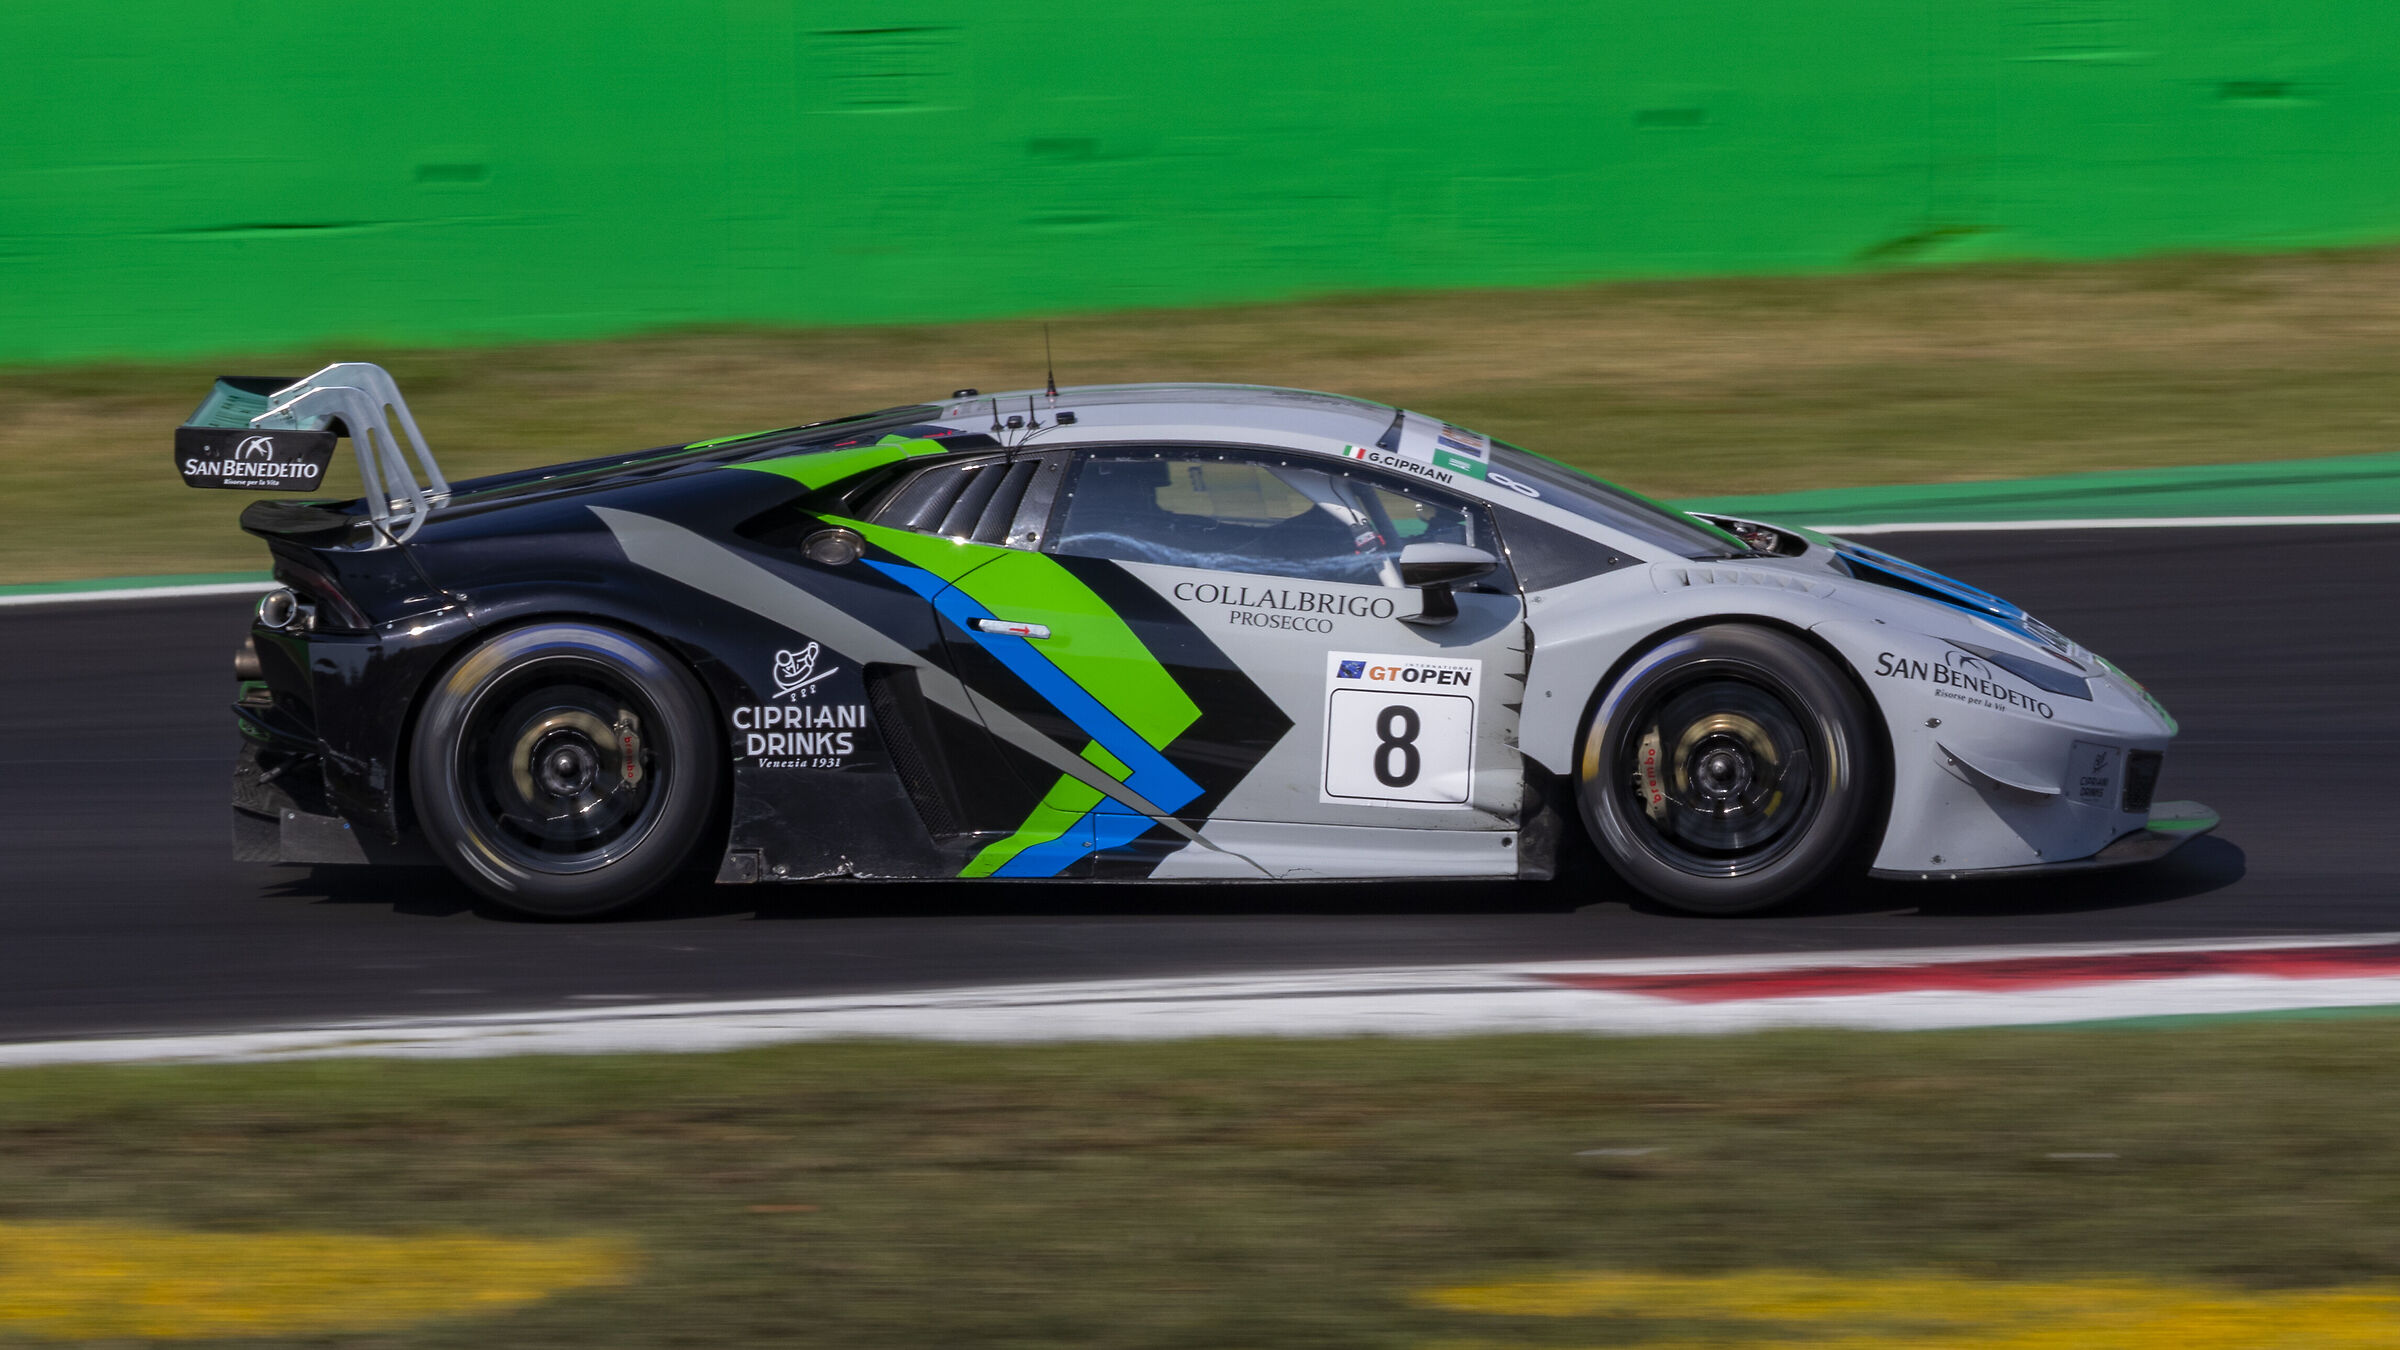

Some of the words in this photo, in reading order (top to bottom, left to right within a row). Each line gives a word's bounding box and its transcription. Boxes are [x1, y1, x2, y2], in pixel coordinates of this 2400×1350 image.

[184, 459, 224, 477] SAN
[223, 459, 319, 479] BENEDETTO
[1368, 452, 1452, 485] G.CIPRIANI
[1487, 472, 1540, 498] 8
[1173, 582, 1395, 620] COLLALBRIGO
[1229, 610, 1333, 634] PROSECCO
[1405, 663, 1473, 671] INTERNATIONAL
[1874, 652, 1928, 682] SAN
[1933, 662, 2054, 719] BENEDETTO
[1934, 688, 1966, 701] Risorse
[1967, 697, 1982, 705] per
[1984, 700, 1992, 708] la
[732, 705, 866, 729] CIPRIANI
[746, 732, 855, 756] DRINKS
[1373, 705, 1421, 789] 8
[758, 758, 807, 768] Venezia
[812, 757, 841, 768] 1931
[1643, 748, 1662, 804] brembo
